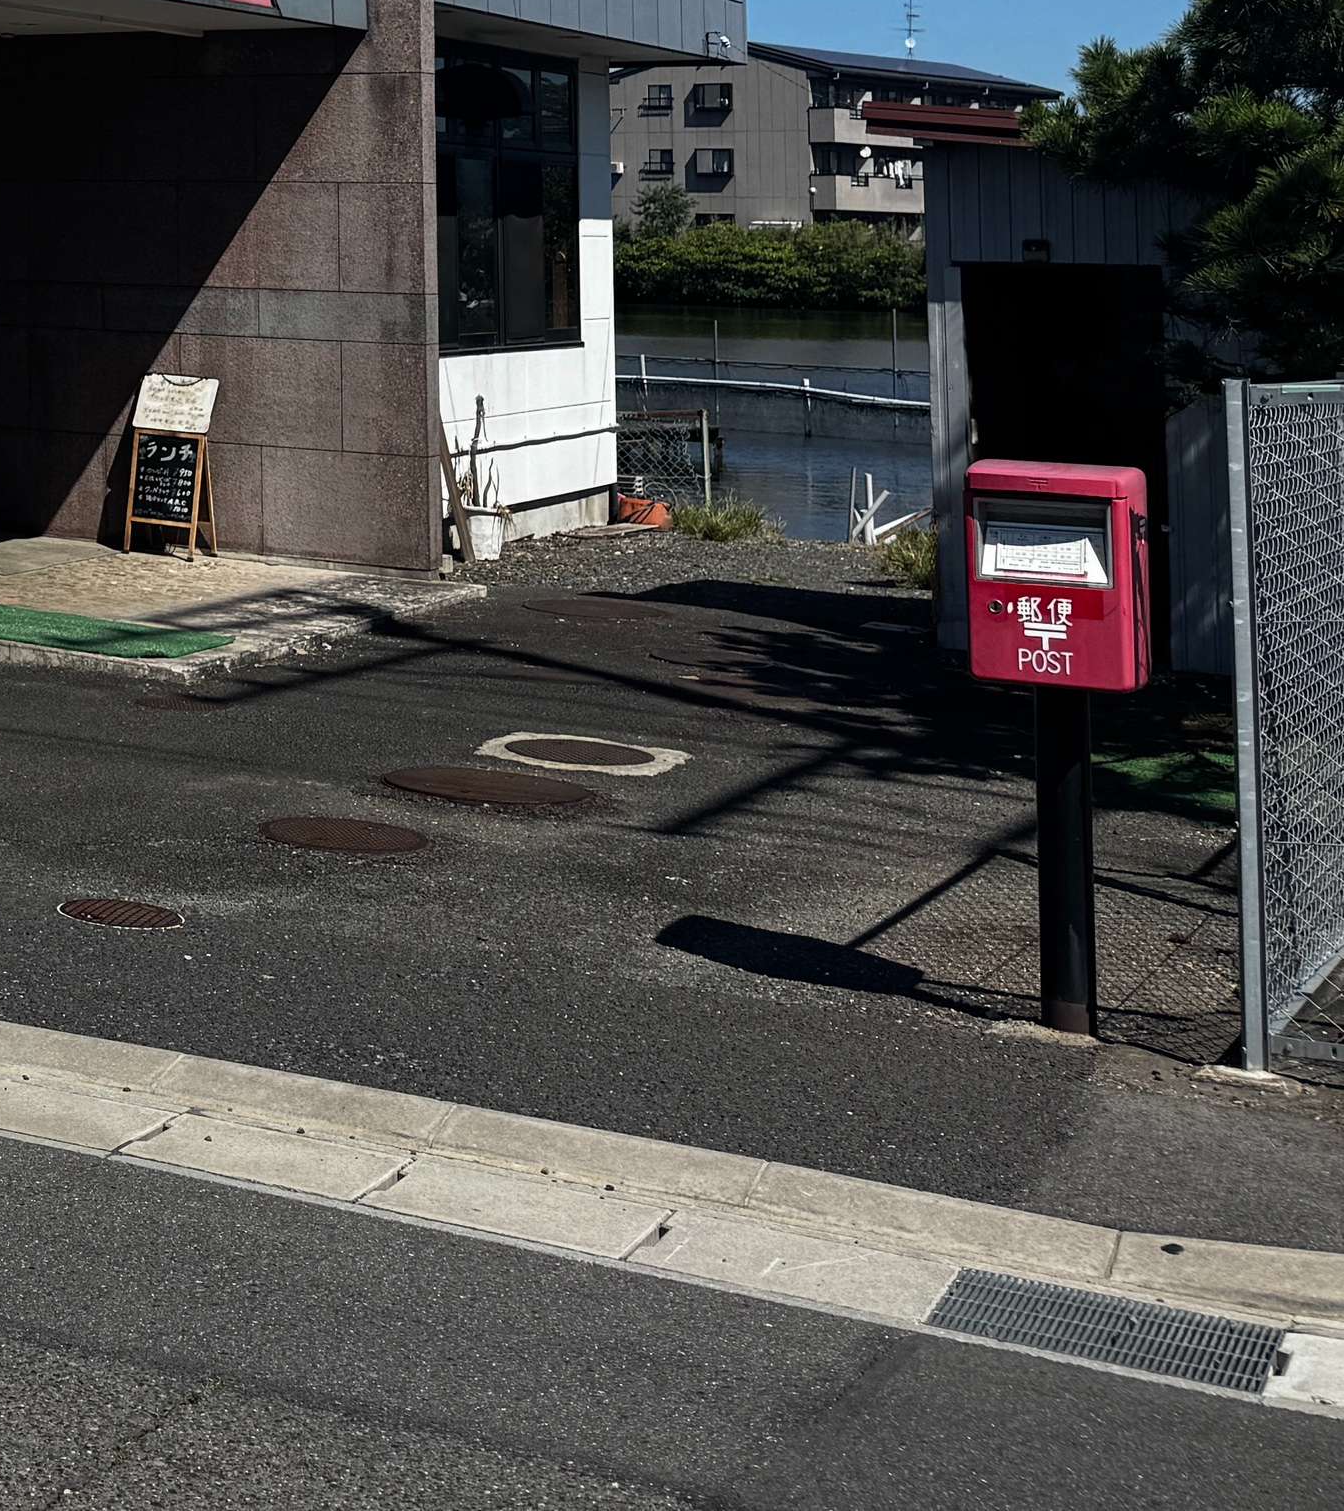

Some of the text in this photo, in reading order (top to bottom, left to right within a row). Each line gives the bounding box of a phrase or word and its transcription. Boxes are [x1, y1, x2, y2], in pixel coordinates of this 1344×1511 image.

[145, 441, 193, 462] ランチ
[1016, 596, 1073, 627] 郵便
[1017, 648, 1074, 675] POST
